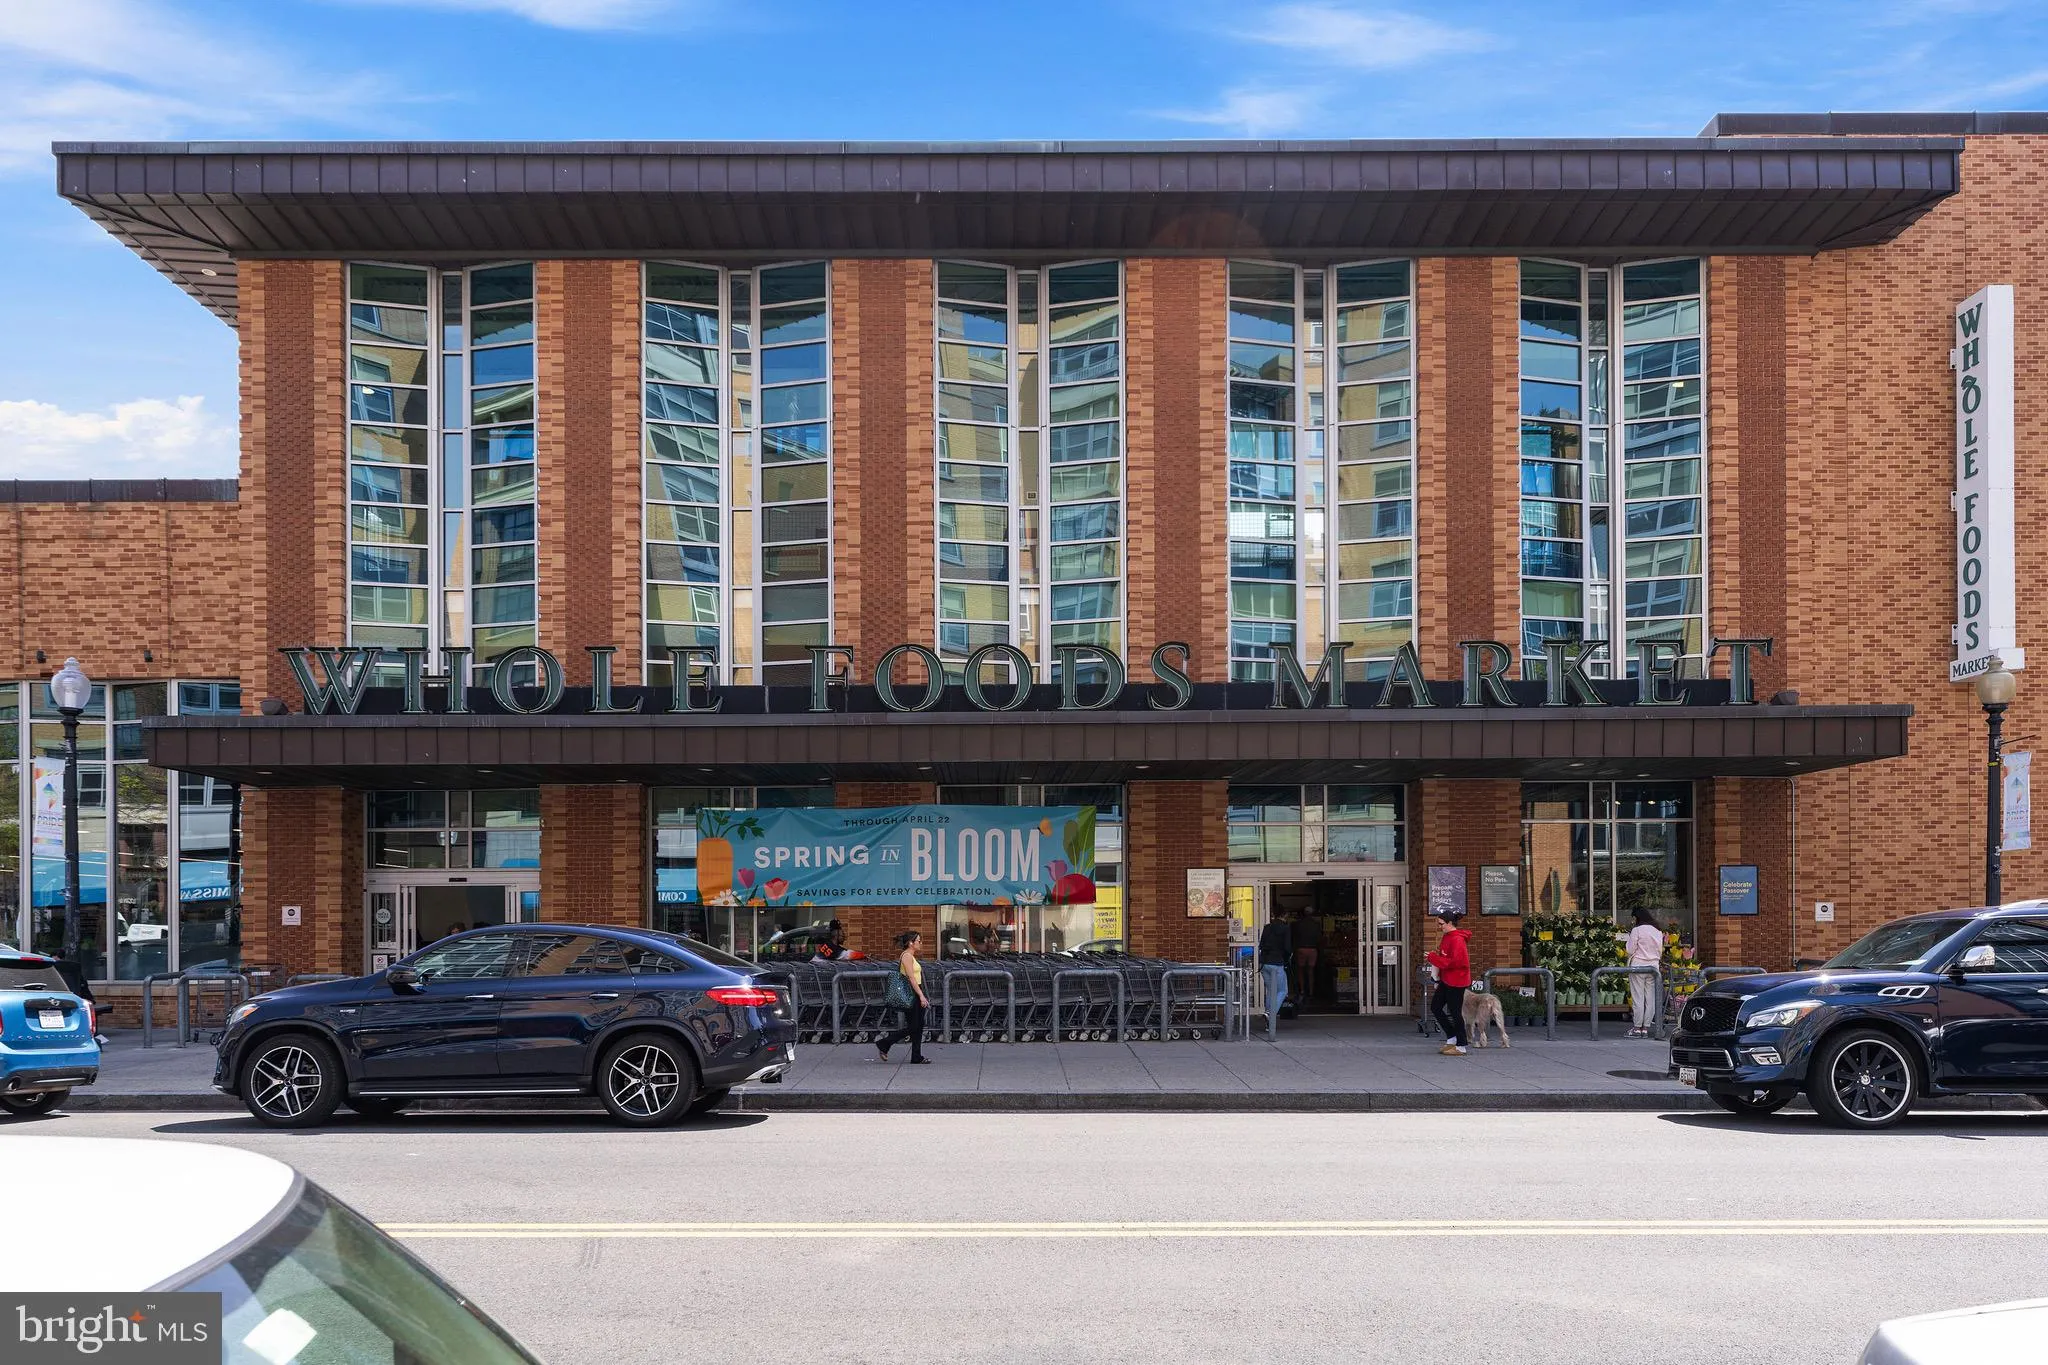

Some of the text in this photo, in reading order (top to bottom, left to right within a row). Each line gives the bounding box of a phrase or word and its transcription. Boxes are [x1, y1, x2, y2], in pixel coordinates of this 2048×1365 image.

[1958, 302, 1983, 650] WHOLE FOODS
[279, 637, 1774, 716] WHOLE FOODS MARKET
[843, 815, 950, 827] THROUGH APRIL 22
[754, 827, 1040, 882] SPRING IN BLOOM
[796, 887, 996, 897] SAVINGS FOR EVERY CELEBRATION.
